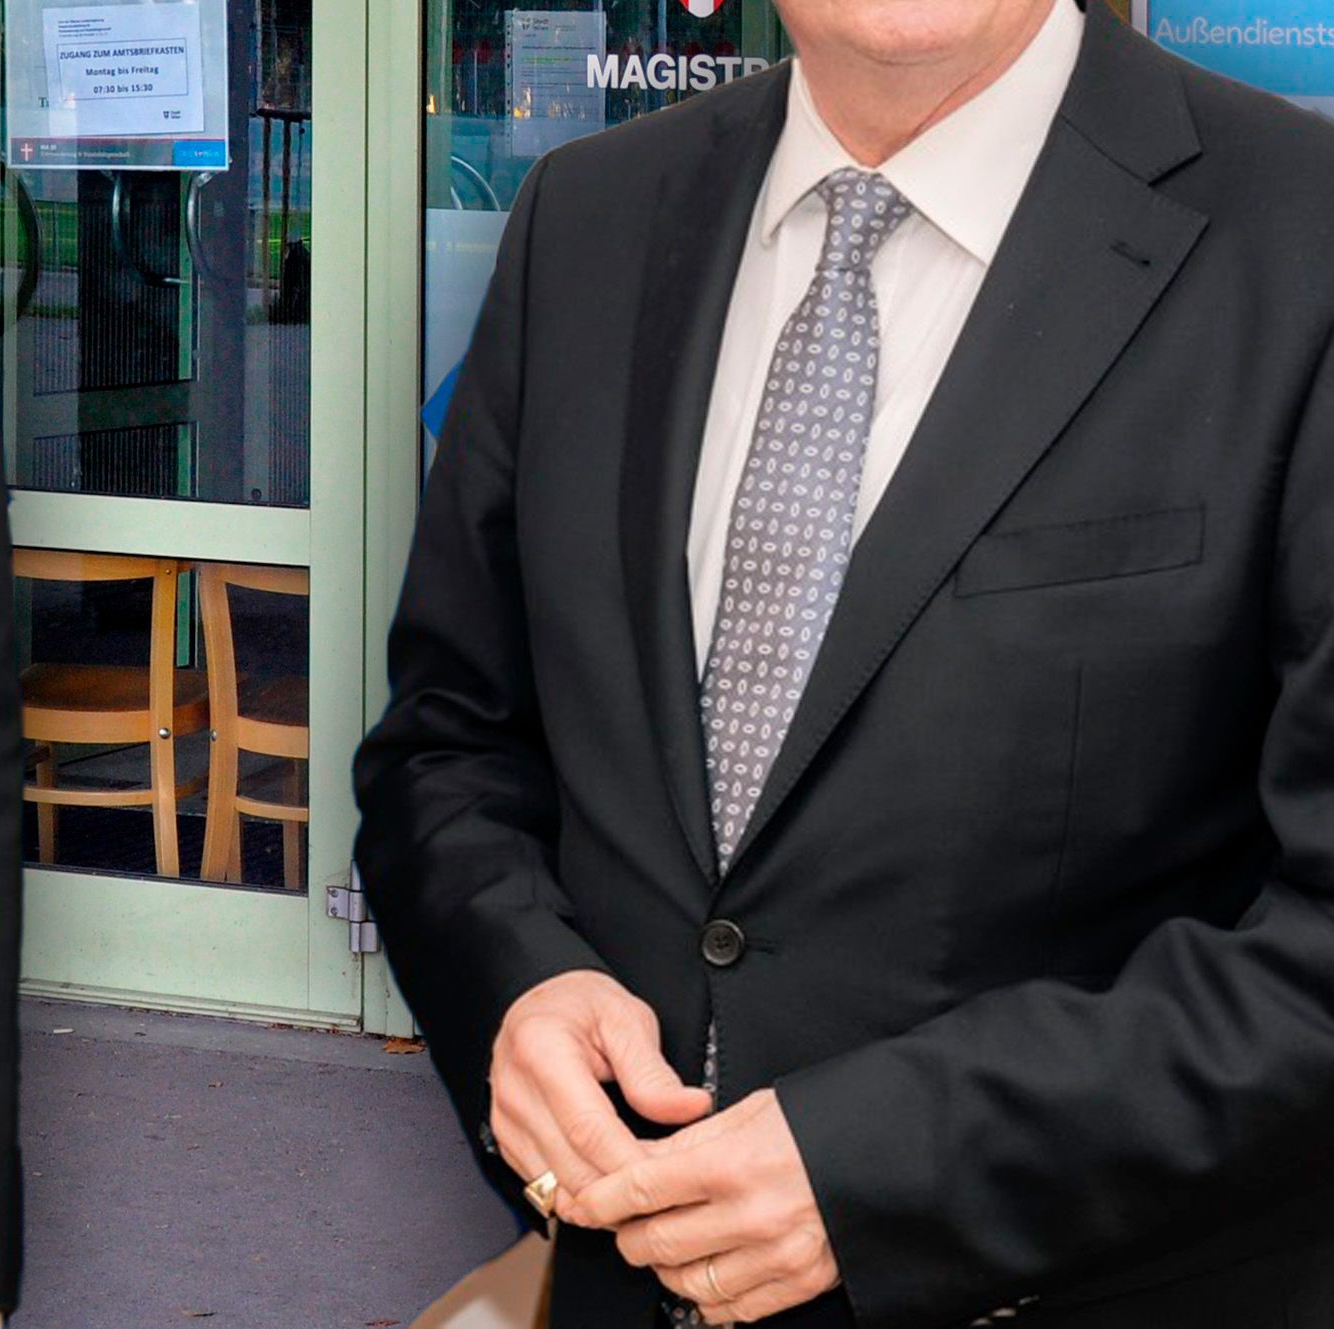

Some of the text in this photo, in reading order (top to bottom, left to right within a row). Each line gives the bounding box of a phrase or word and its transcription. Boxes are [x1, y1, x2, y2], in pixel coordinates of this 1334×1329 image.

[59, 46, 185, 60] ZUGANG ZUM AMTSBRIEFKASTEN
[85, 66, 159, 77] Montag bis Freitag
[93, 83, 154, 94] 07:30 bis 15:30
